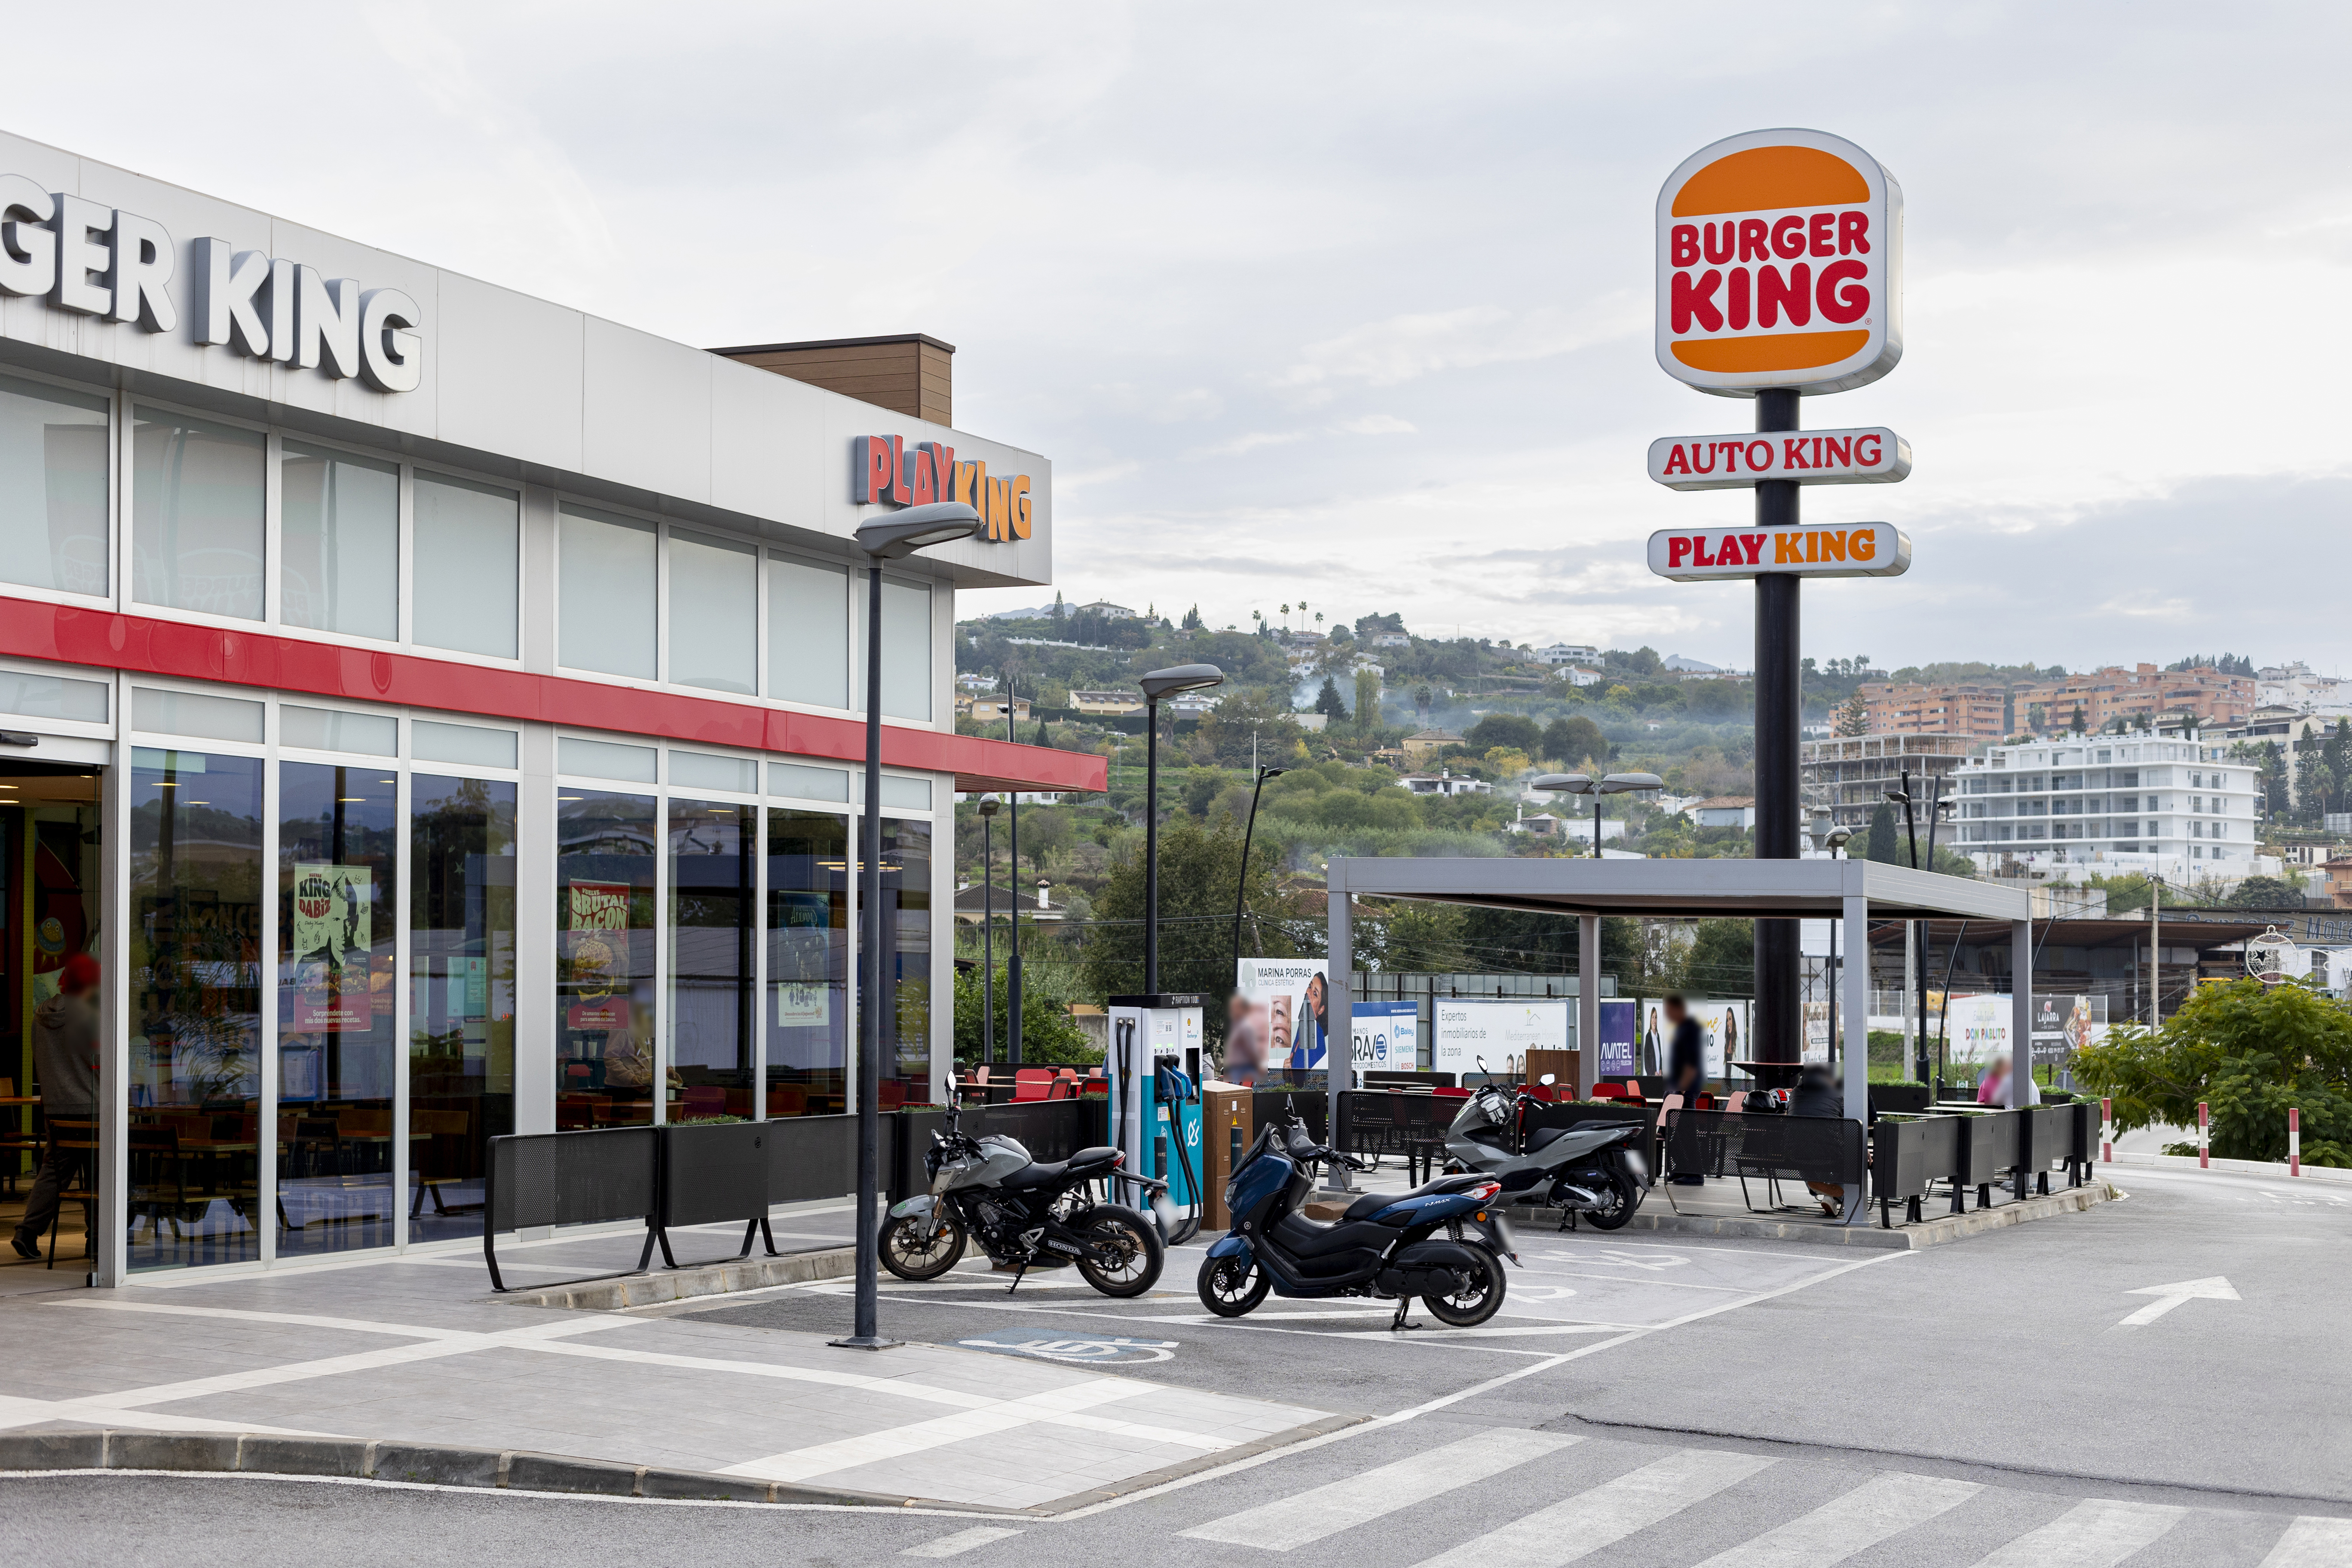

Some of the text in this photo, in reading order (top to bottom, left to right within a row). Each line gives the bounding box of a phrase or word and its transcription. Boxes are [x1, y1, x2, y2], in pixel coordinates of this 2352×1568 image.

[1671, 211, 1870, 268] BURGER
[1671, 259, 1870, 334] KING
[194, 236, 422, 393] KING
[1663, 433, 1883, 475] AUTO KING
[1669, 529, 1876, 568] PLAY KING
[299, 878, 331, 897] KING
[582, 887, 600, 895] VUELVE
[572, 886, 628, 916] BRUTAL
[571, 907, 627, 931] BACON
[1258, 968, 1311, 978] MARINA PORRAS
[1258, 978, 1295, 986] CLÍNICA ESTÉTICA
[1175, 995, 1190, 1004] RAPTION
[1441, 1010, 1467, 1023] Expertos
[1400, 1027, 1414, 1036] Balay
[1441, 1027, 1486, 1039] inmobiliarios de
[1505, 1029, 1559, 1041] Mediterranean Homes
[1966, 1027, 2006, 1041] DON PABLITO
[1395, 1045, 1414, 1054] SIEMENS
[1441, 1045, 1461, 1057] la zona
[1600, 1042, 1632, 1060] AVATEL
[1049, 1241, 1081, 1254] HONDA
